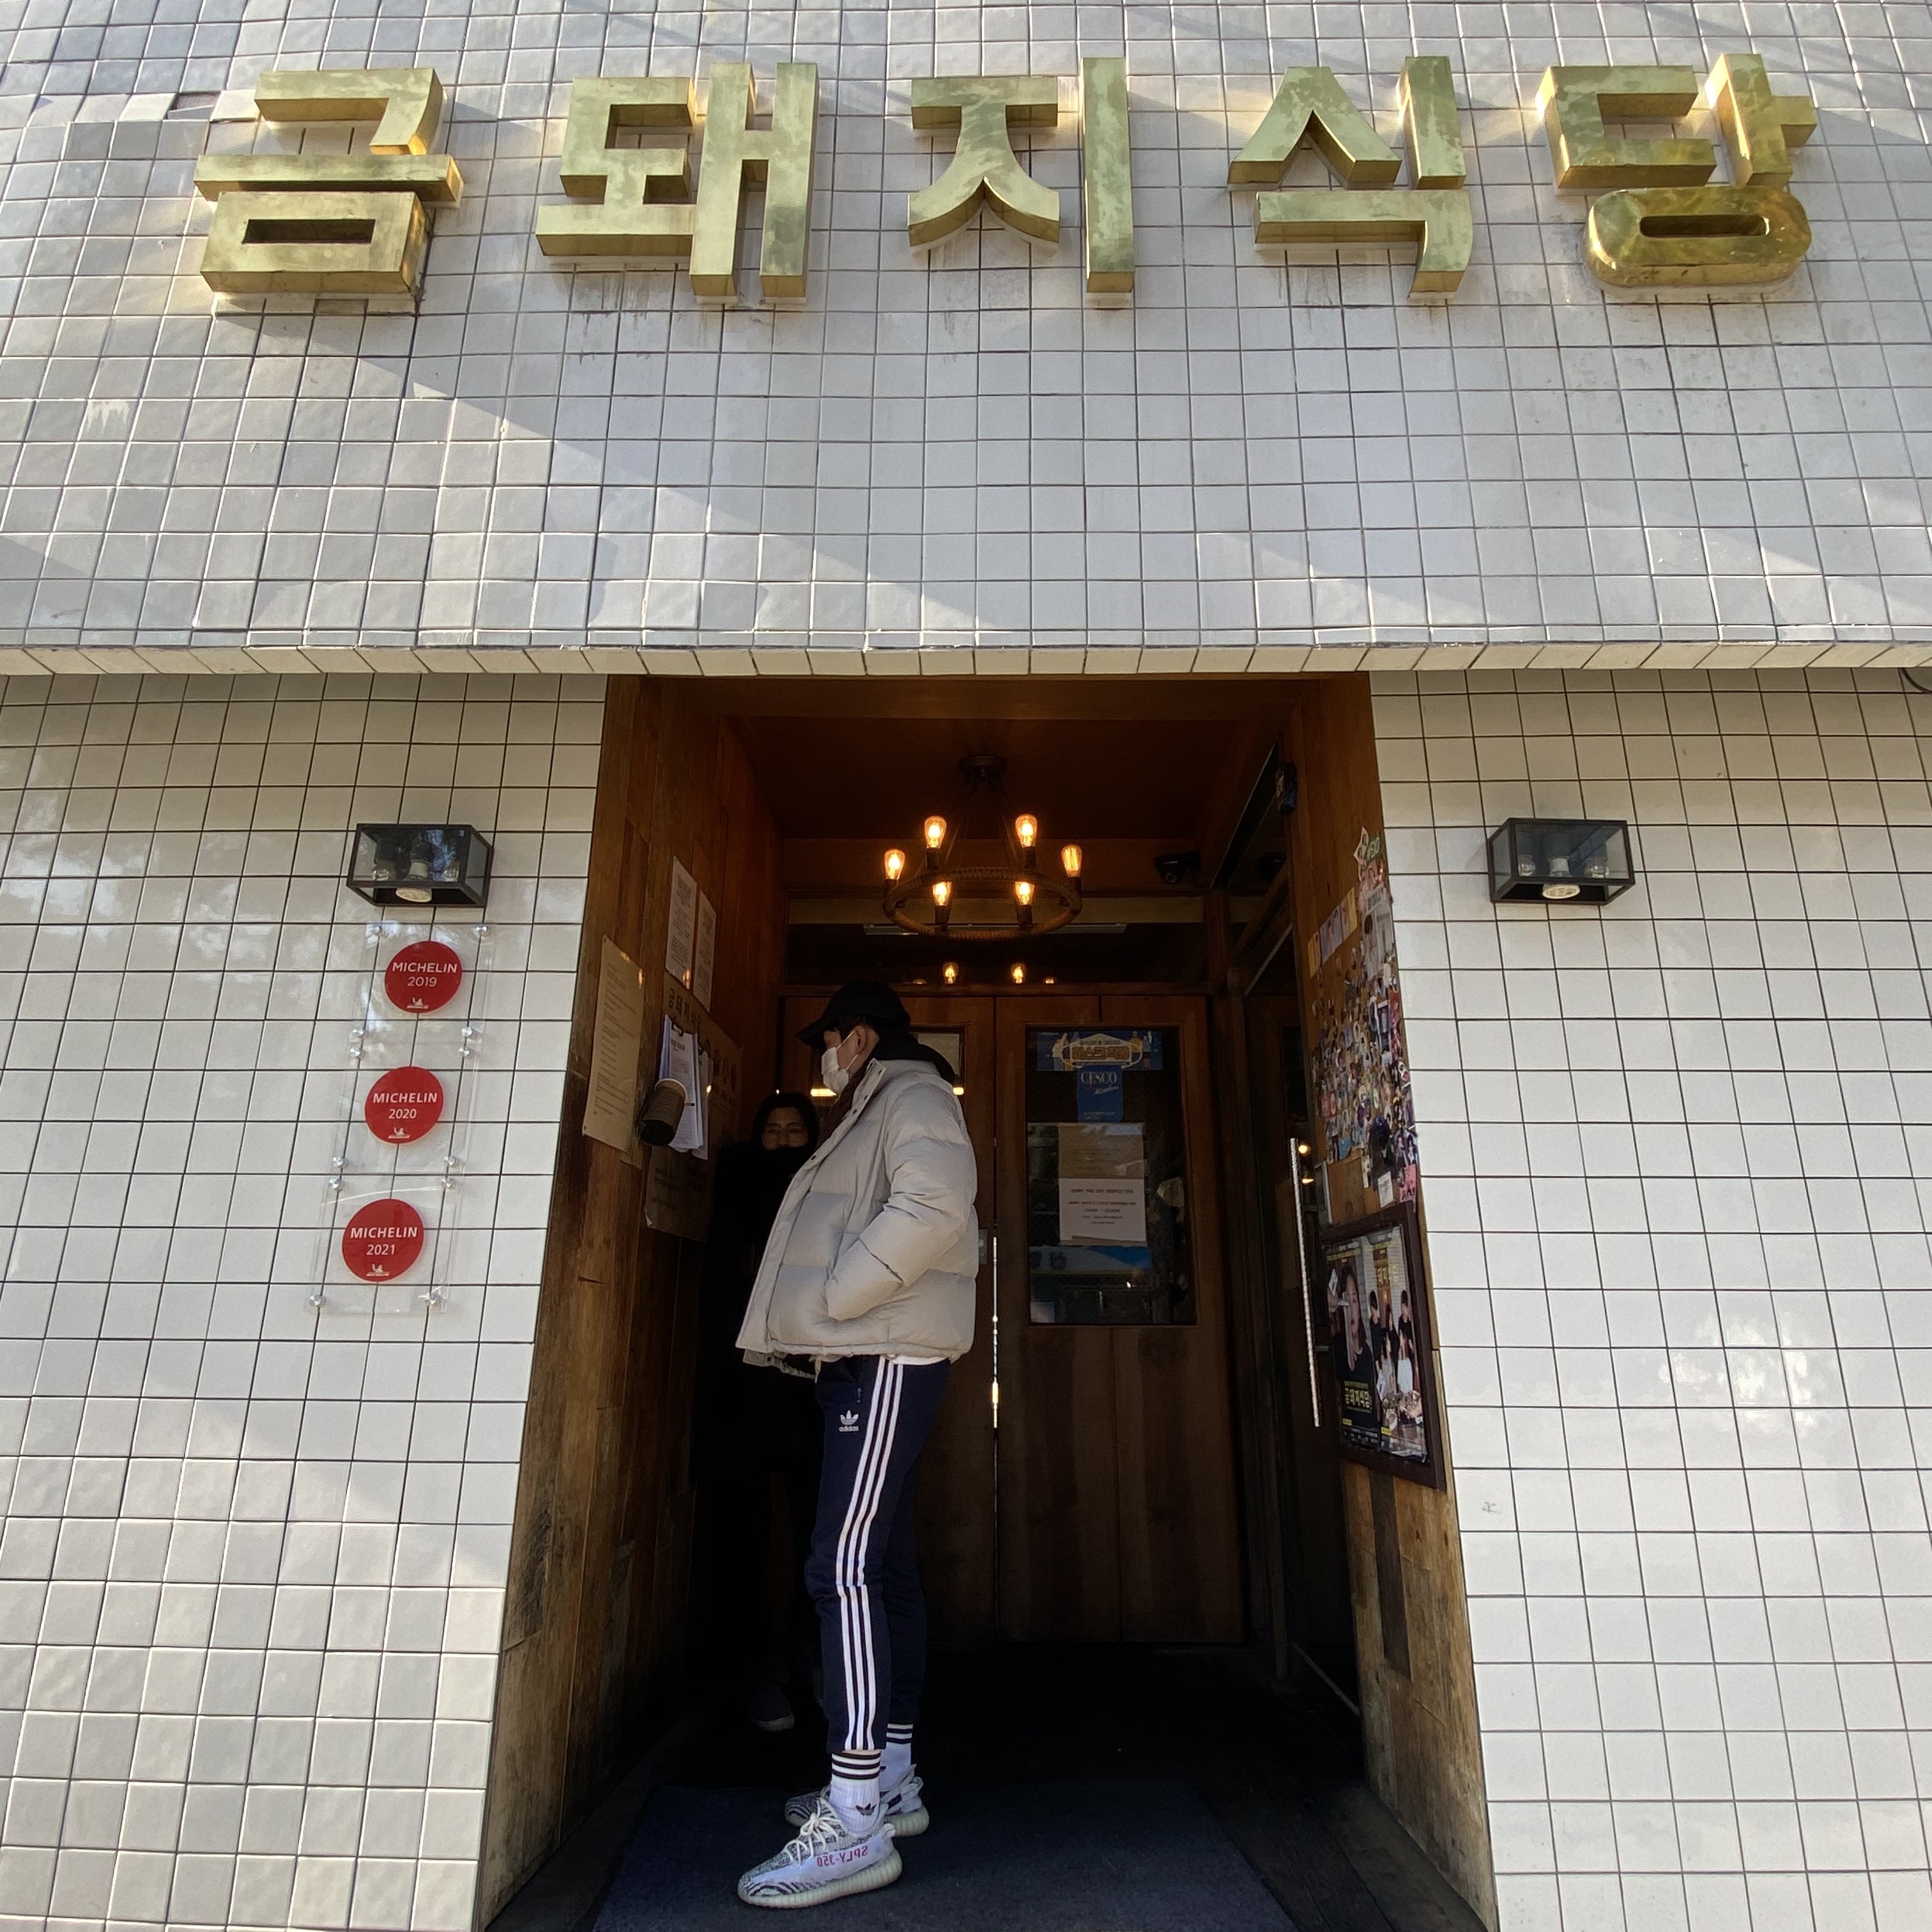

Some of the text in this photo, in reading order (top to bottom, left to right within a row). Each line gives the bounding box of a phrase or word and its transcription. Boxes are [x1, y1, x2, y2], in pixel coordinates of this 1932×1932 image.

[194, 52, 1816, 303] 금돼지식당
[392, 962, 457, 974] MICHELIN
[407, 976, 437, 987] 2019
[1080, 1071, 1118, 1084] CESCO
[372, 1092, 438, 1103] MICHELIN
[388, 1108, 417, 1119] 2020
[350, 1227, 417, 1238] MICHELIN
[366, 1243, 396, 1255] 2021
